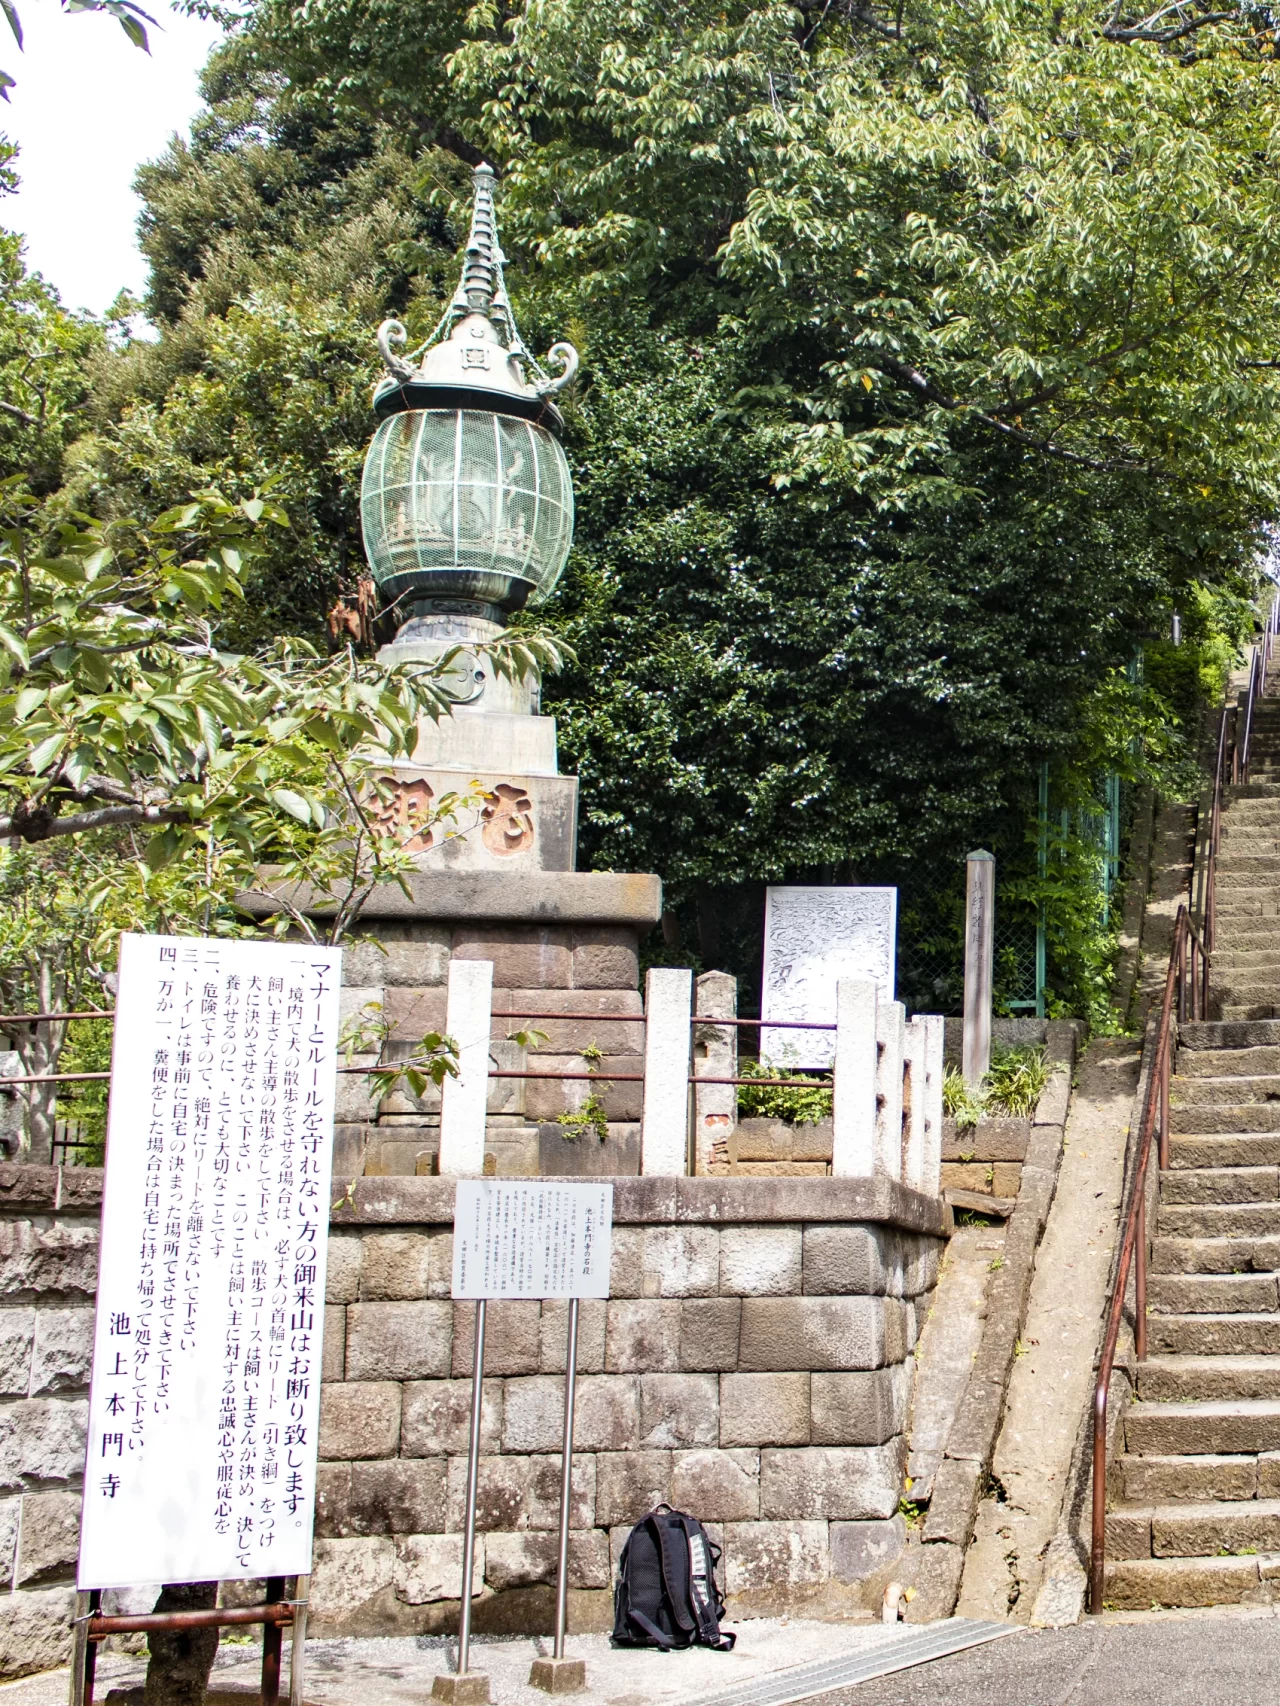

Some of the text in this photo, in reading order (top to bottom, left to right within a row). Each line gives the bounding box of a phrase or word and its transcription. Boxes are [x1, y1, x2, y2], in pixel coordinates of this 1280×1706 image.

[128, 946, 177, 1462] 四、万が一、糞便をした場合は自宅に持ち帰って処分して下さい。
[283, 963, 332, 1528] マナーとルールを守れない方の御来山はお断り致します。
[582, 1207, 593, 1275] 池上本門寺の石段
[99, 1311, 132, 1499] 池上本門寺
